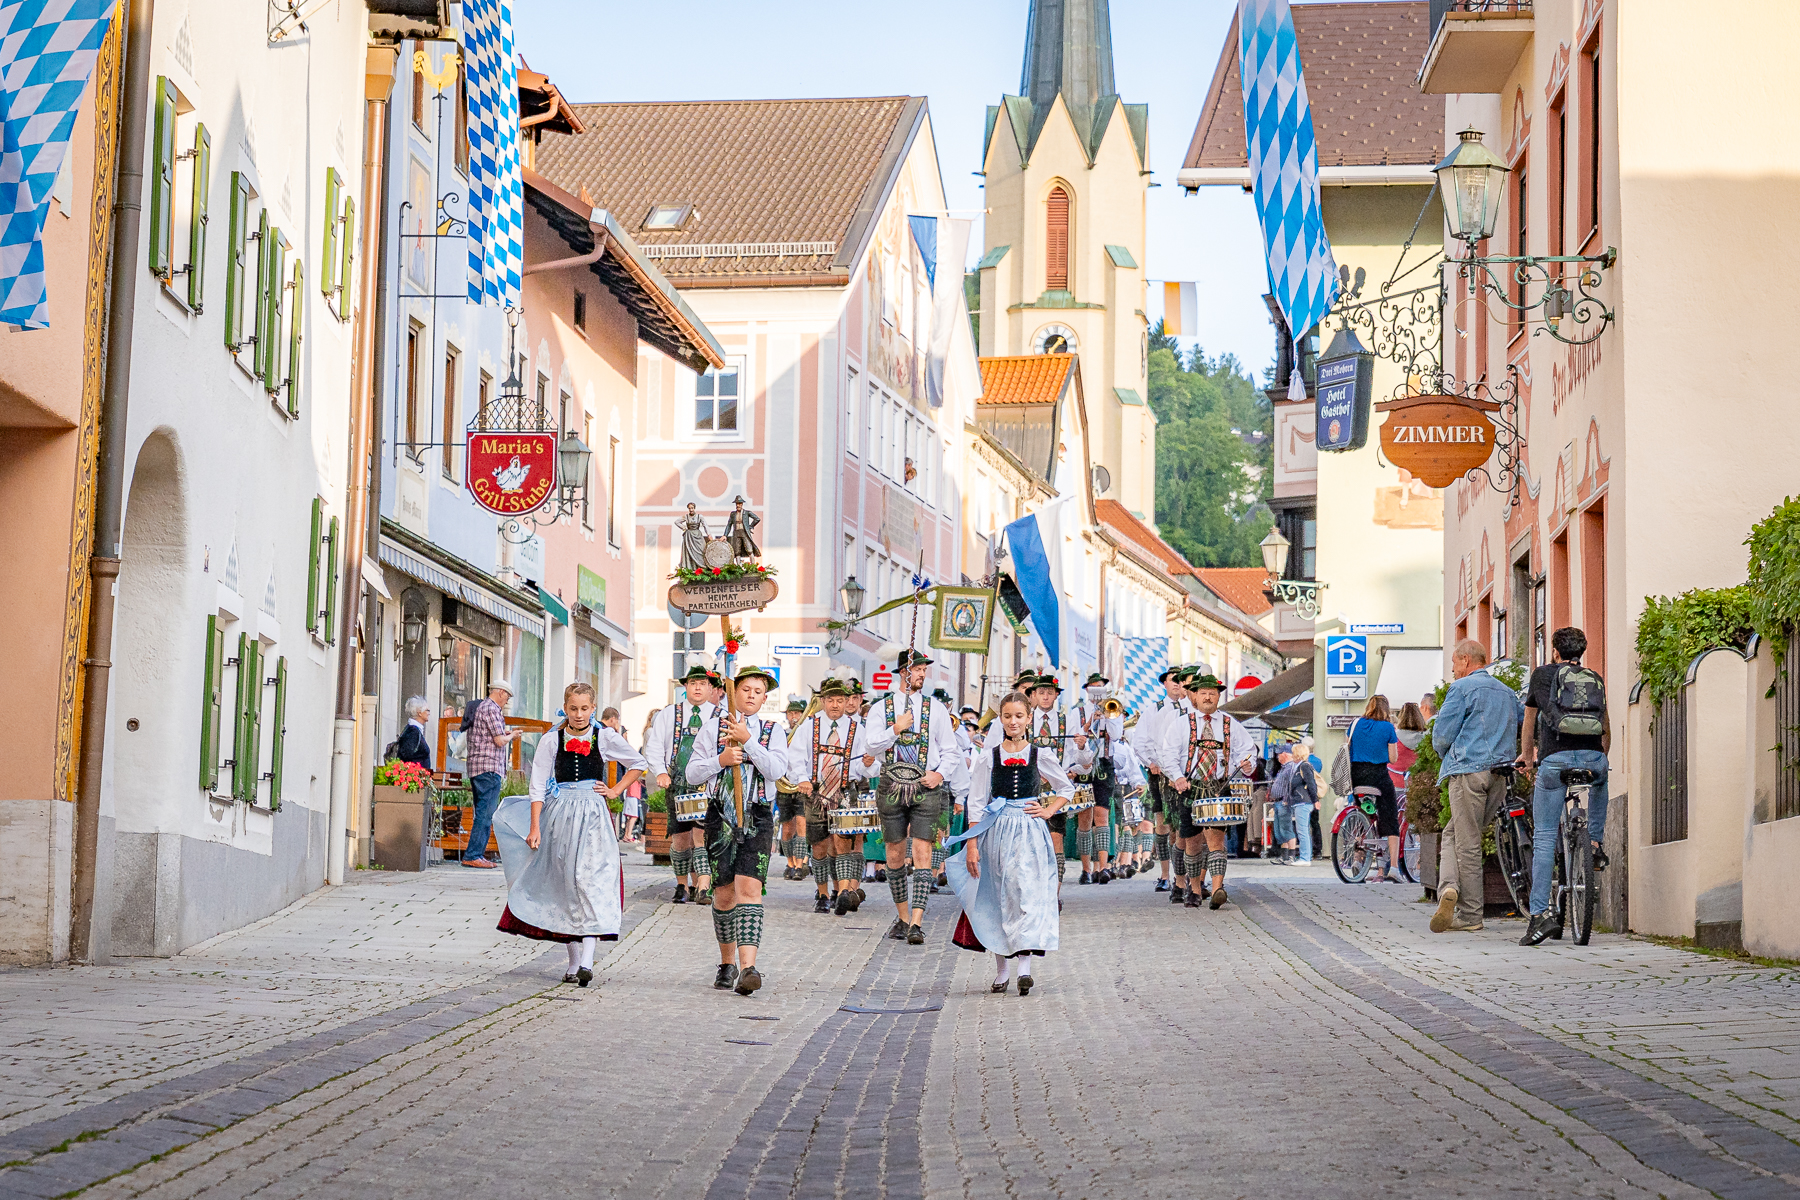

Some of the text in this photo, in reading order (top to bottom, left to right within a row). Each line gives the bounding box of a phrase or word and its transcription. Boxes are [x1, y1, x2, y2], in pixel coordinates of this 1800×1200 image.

[1326, 386, 1347, 405] Hotel
[1321, 400, 1351, 419] Gasthof
[1393, 426, 1485, 443] ZIMMER
[480, 439, 544, 454] Maria's
[474, 477, 550, 512] Grill-Stube
[683, 583, 761, 595] WERDENFELSER
[688, 600, 758, 610] PARTENKIRCHEN
[708, 593, 738, 602] HEIMAT
[1339, 648, 1357, 673] P
[1354, 664, 1363, 673] 13
